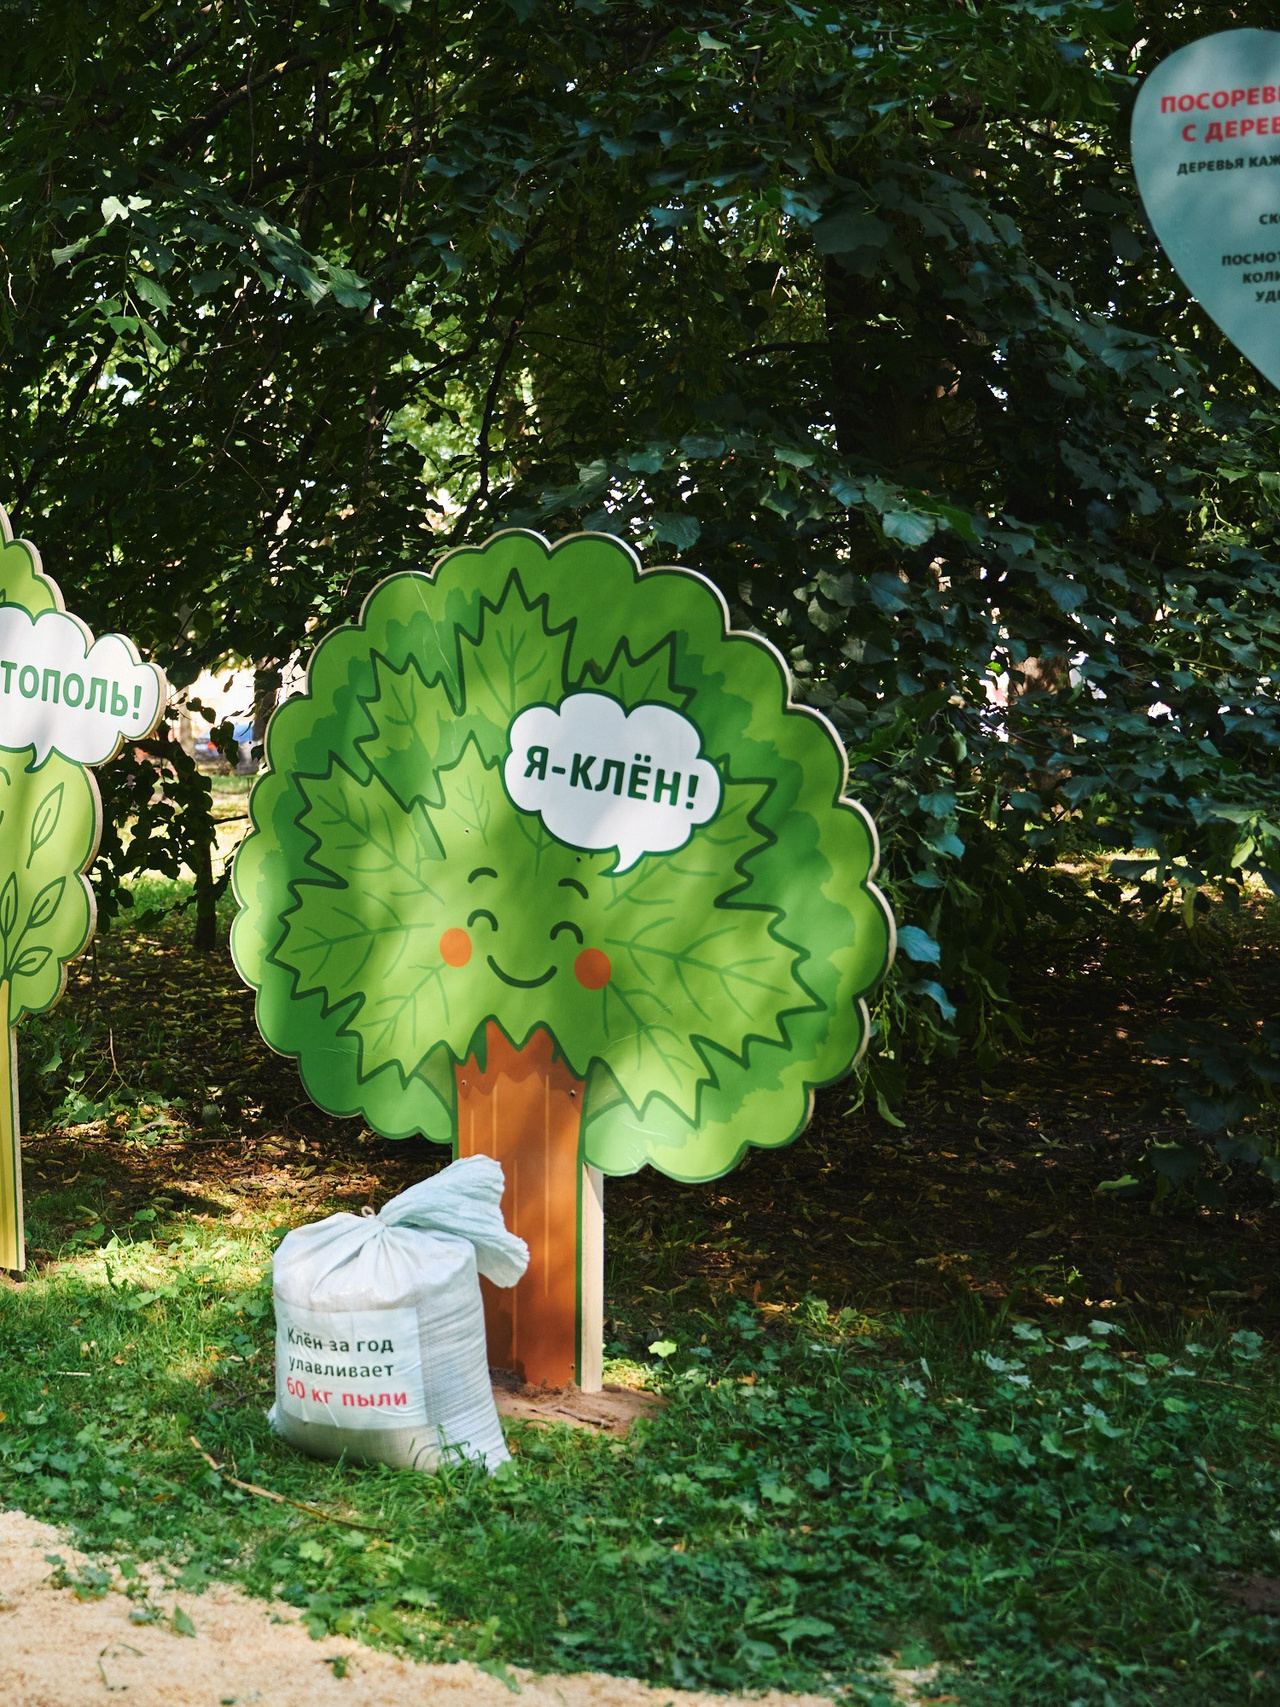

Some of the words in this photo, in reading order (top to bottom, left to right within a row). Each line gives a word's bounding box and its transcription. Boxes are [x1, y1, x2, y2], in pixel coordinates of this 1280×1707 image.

[1160, 85, 1280, 114] ПОСОРЕВ
[1182, 123, 1197, 143] С
[1177, 157, 1244, 177] ДЕРЕВЬЯ
[1259, 212, 1280, 226] СК
[1221, 251, 1280, 267] ПОСМО
[1255, 290, 1280, 303] УД
[523, 745, 699, 810] Я-КЛЁН!
[287, 1326, 323, 1350] Клён
[329, 1339, 350, 1352] за
[357, 1339, 394, 1354] год
[288, 1355, 394, 1378] улавливает
[286, 1376, 306, 1399] 60
[311, 1388, 333, 1404] кг
[342, 1392, 407, 1408] пыли
